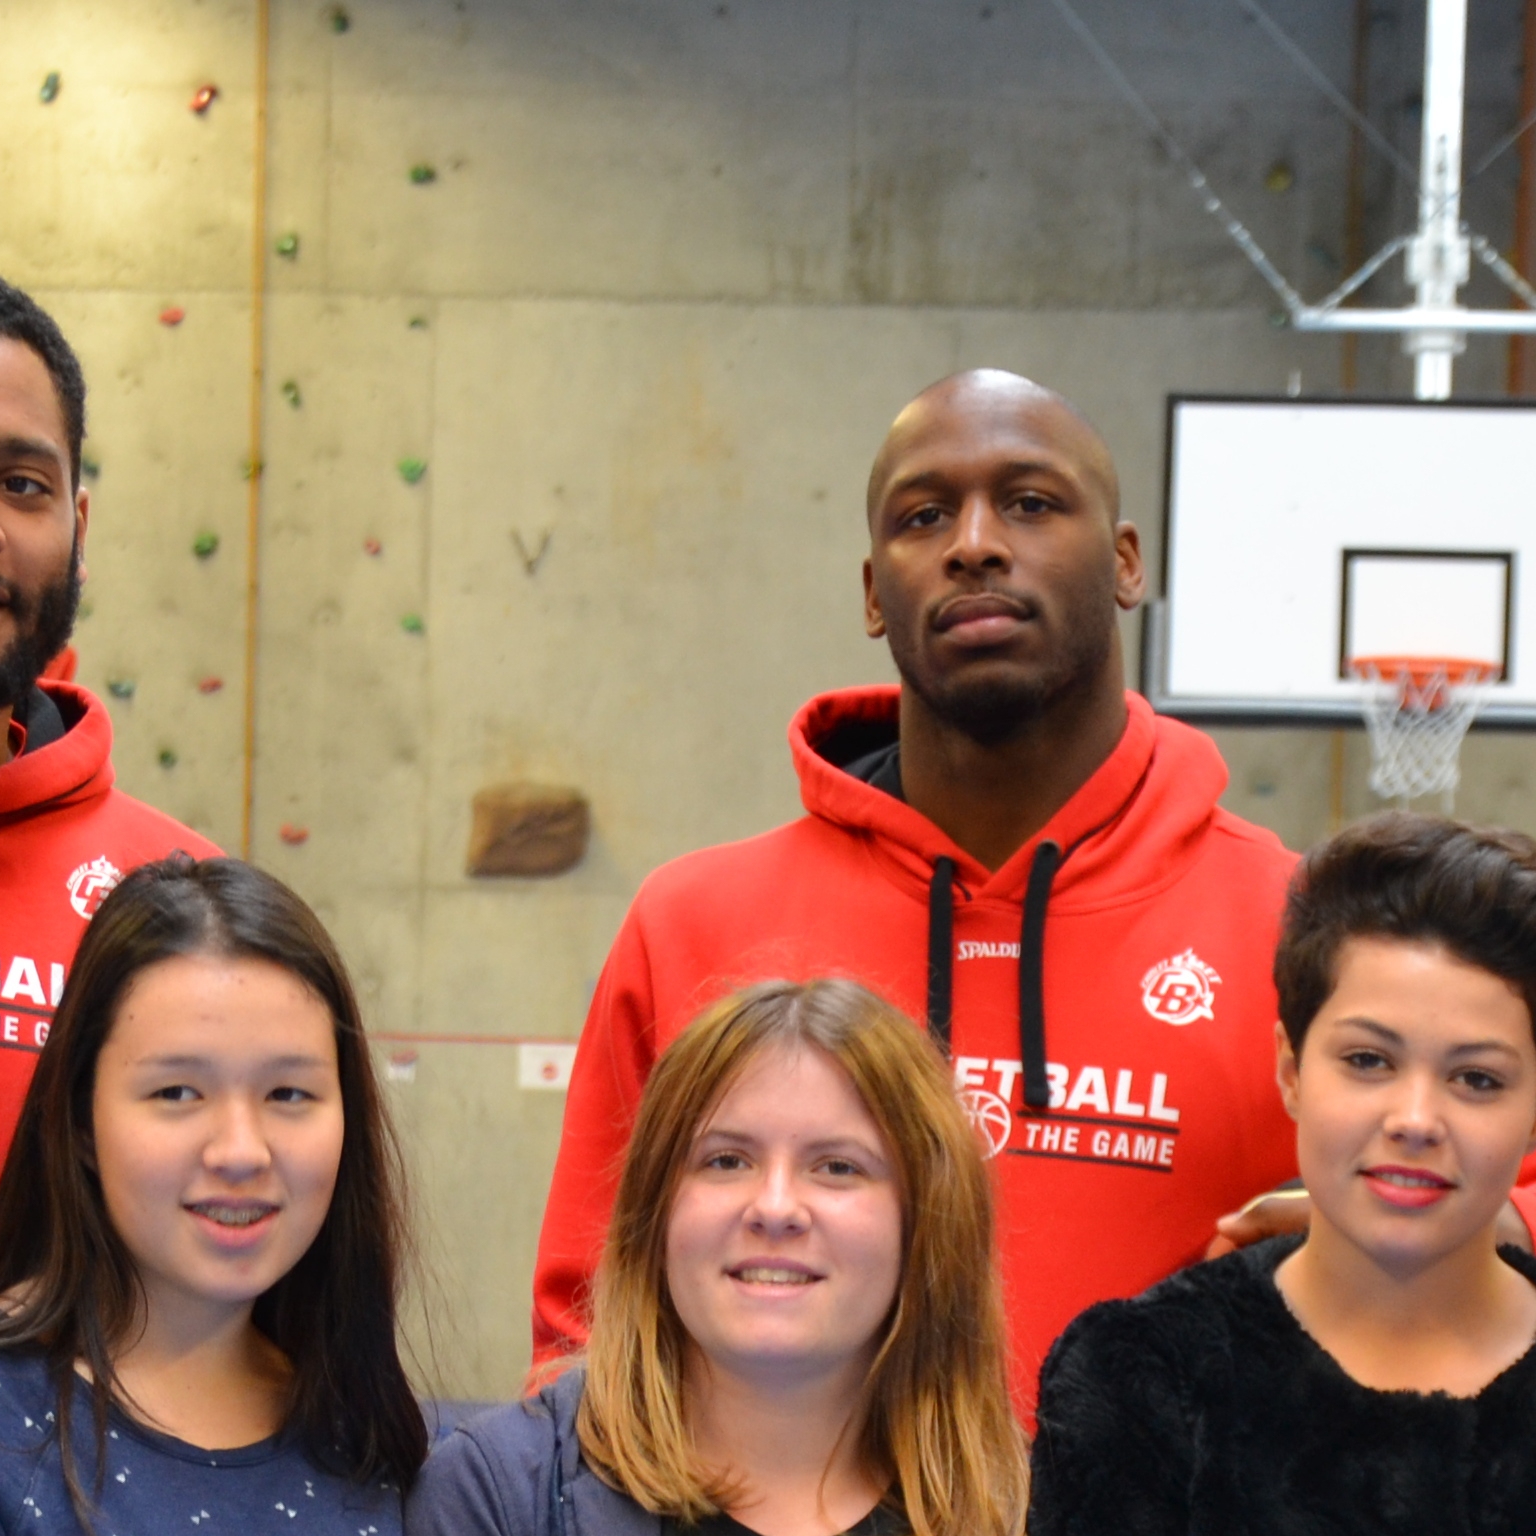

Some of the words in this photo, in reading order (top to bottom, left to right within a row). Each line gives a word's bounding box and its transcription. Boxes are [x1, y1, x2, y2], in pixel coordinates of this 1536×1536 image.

[957, 940, 1021, 961] SPALDI
[953, 1056, 1180, 1123] ETBALL
[1025, 1122, 1081, 1154] THE
[1091, 1129, 1176, 1166] GAME
